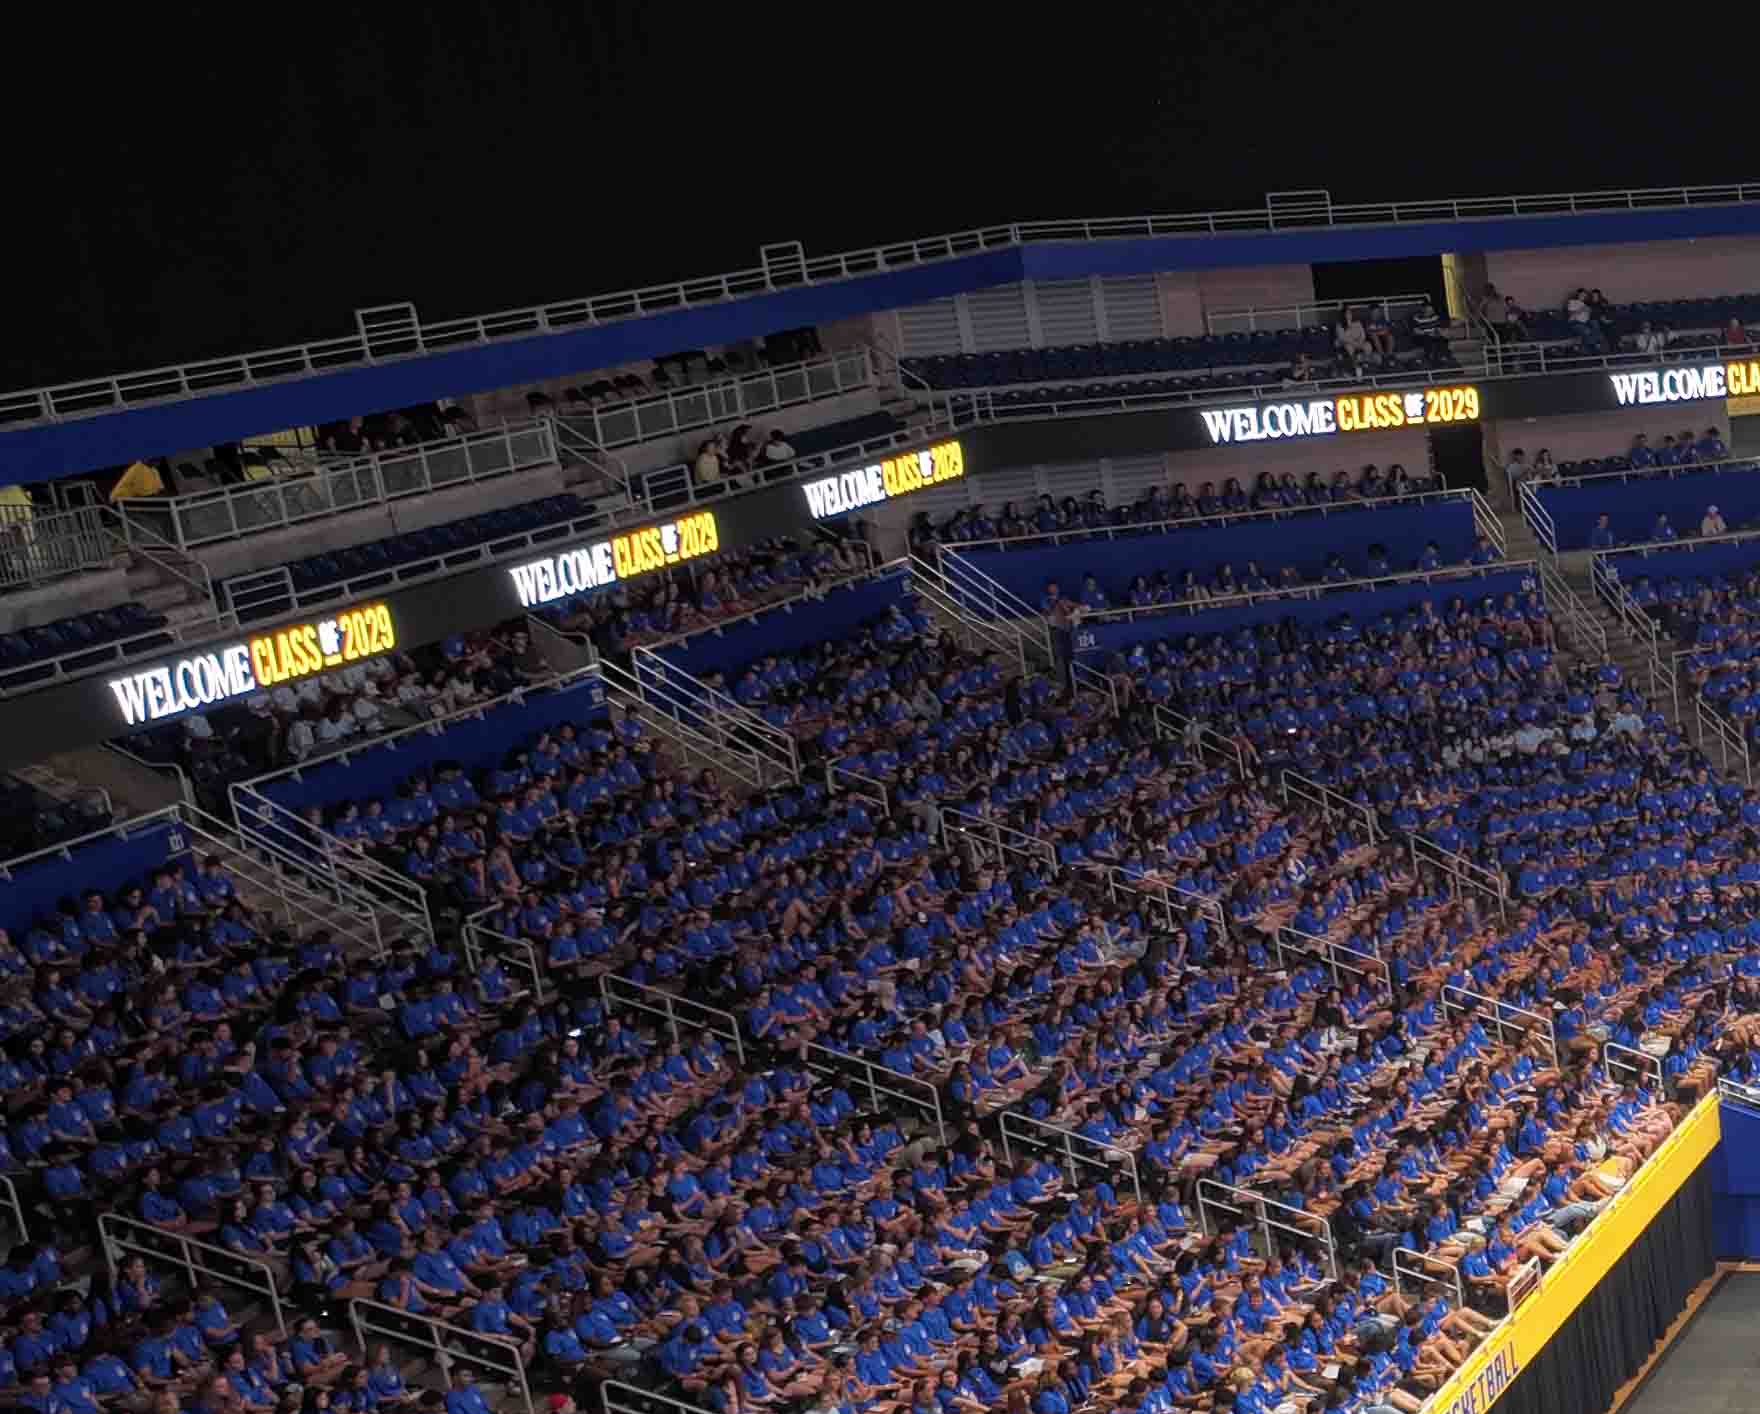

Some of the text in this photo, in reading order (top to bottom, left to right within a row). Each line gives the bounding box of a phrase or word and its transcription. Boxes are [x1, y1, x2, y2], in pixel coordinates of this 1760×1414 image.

[1201, 401, 1335, 442] WELCOME
[1337, 394, 1404, 430] CLASS
[1426, 387, 1478, 422] 2029
[1610, 366, 1726, 404] WELCOME
[802, 463, 885, 518] WELCOME
[883, 454, 919, 496] CLASS
[932, 442, 963, 482] 2029
[509, 542, 615, 606] WELCOME
[612, 528, 662, 577] CLASS
[677, 513, 718, 560] 2029
[109, 645, 254, 724] WELCOME
[248, 625, 321, 685] CLASS
[342, 605, 394, 659] 2029
